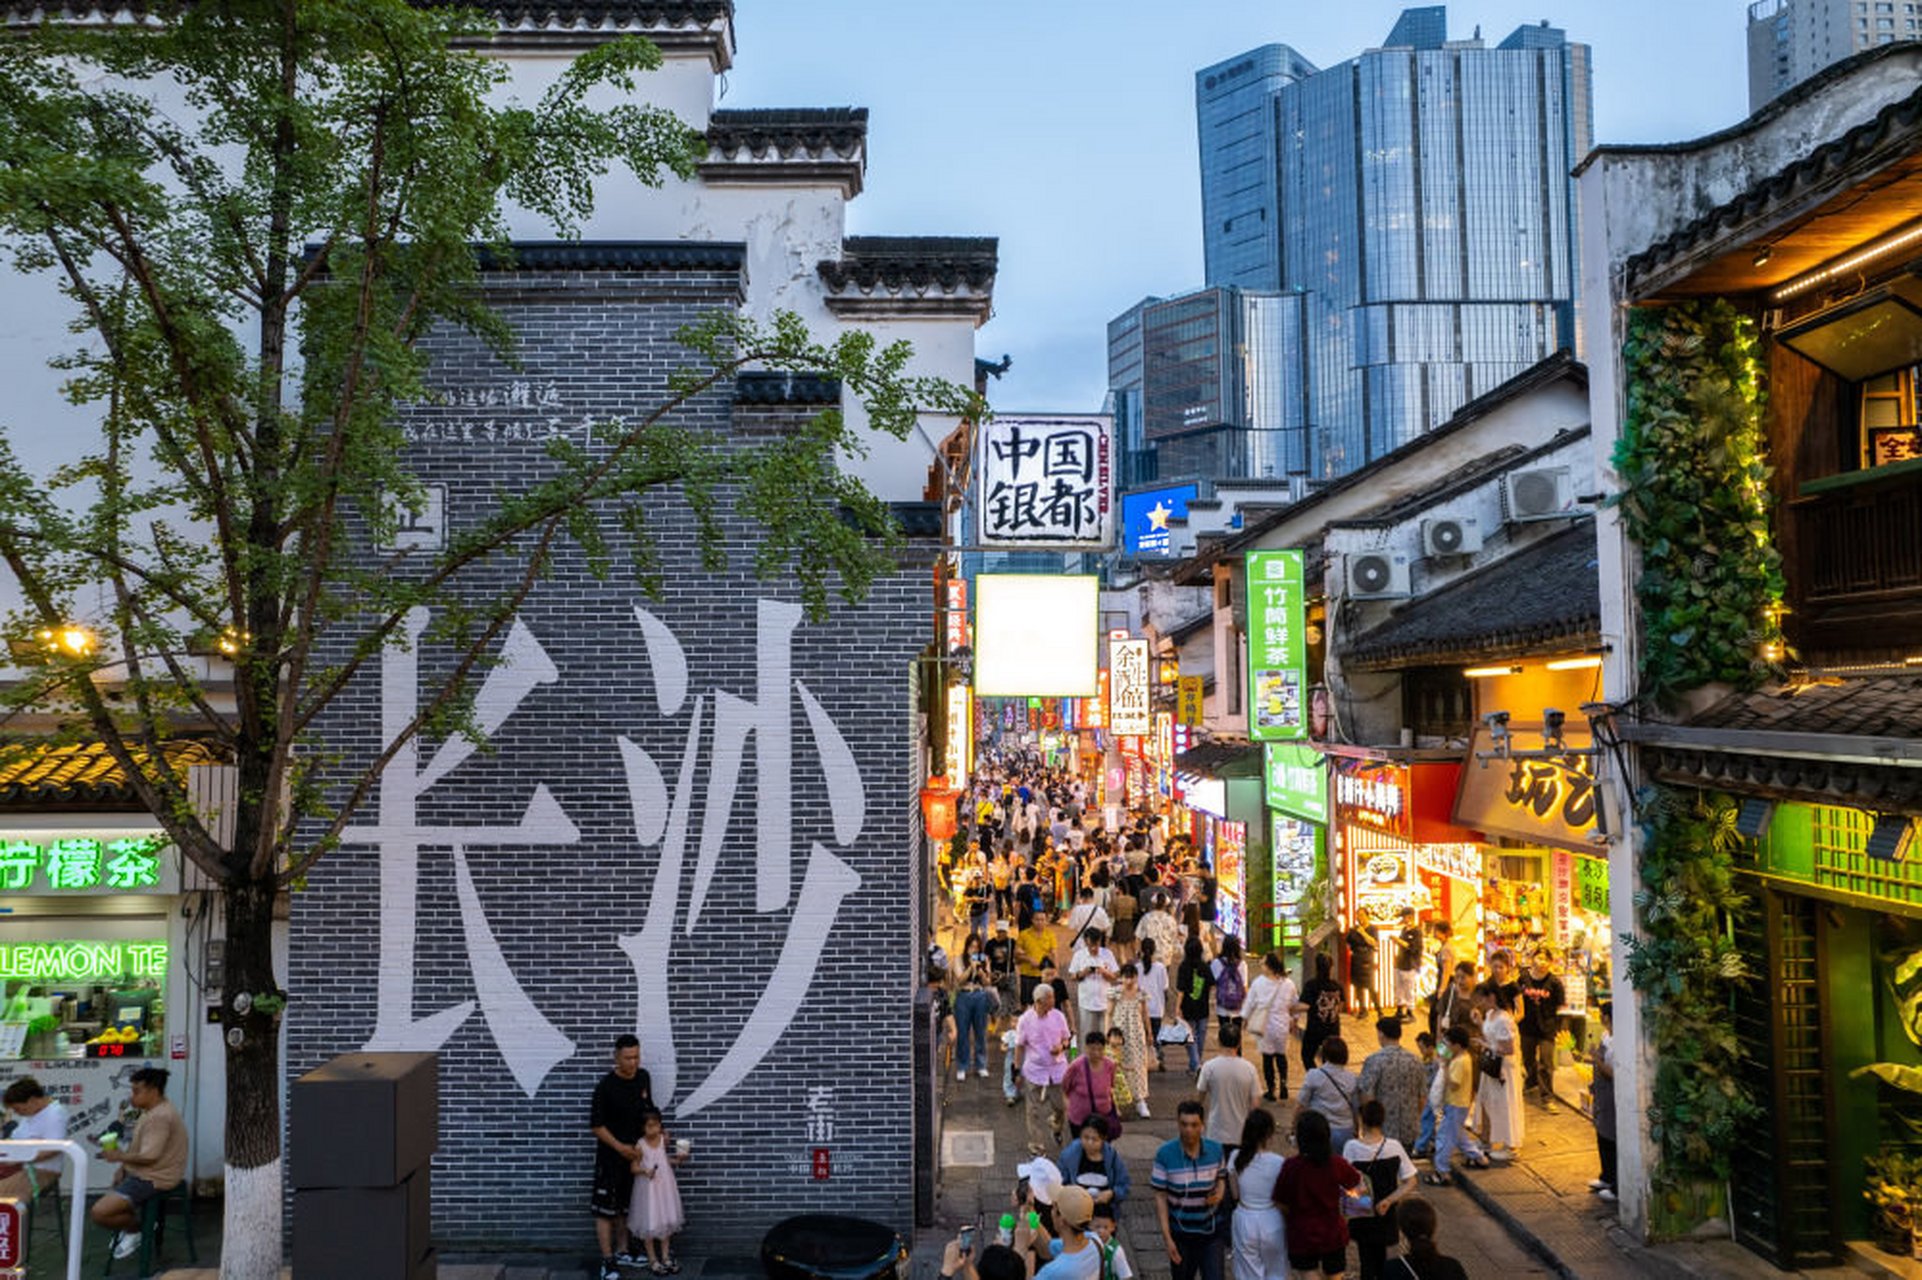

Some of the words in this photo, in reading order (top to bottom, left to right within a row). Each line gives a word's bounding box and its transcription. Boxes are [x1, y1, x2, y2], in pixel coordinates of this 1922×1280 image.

[991, 426, 1094, 484] 中国
[988, 478, 1096, 535] 银都
[0, 838, 159, 889] 柠檬茶
[339, 598, 867, 1119] 长沙
[0, 945, 121, 978] LEMON
[807, 1085, 834, 1142] 老街
